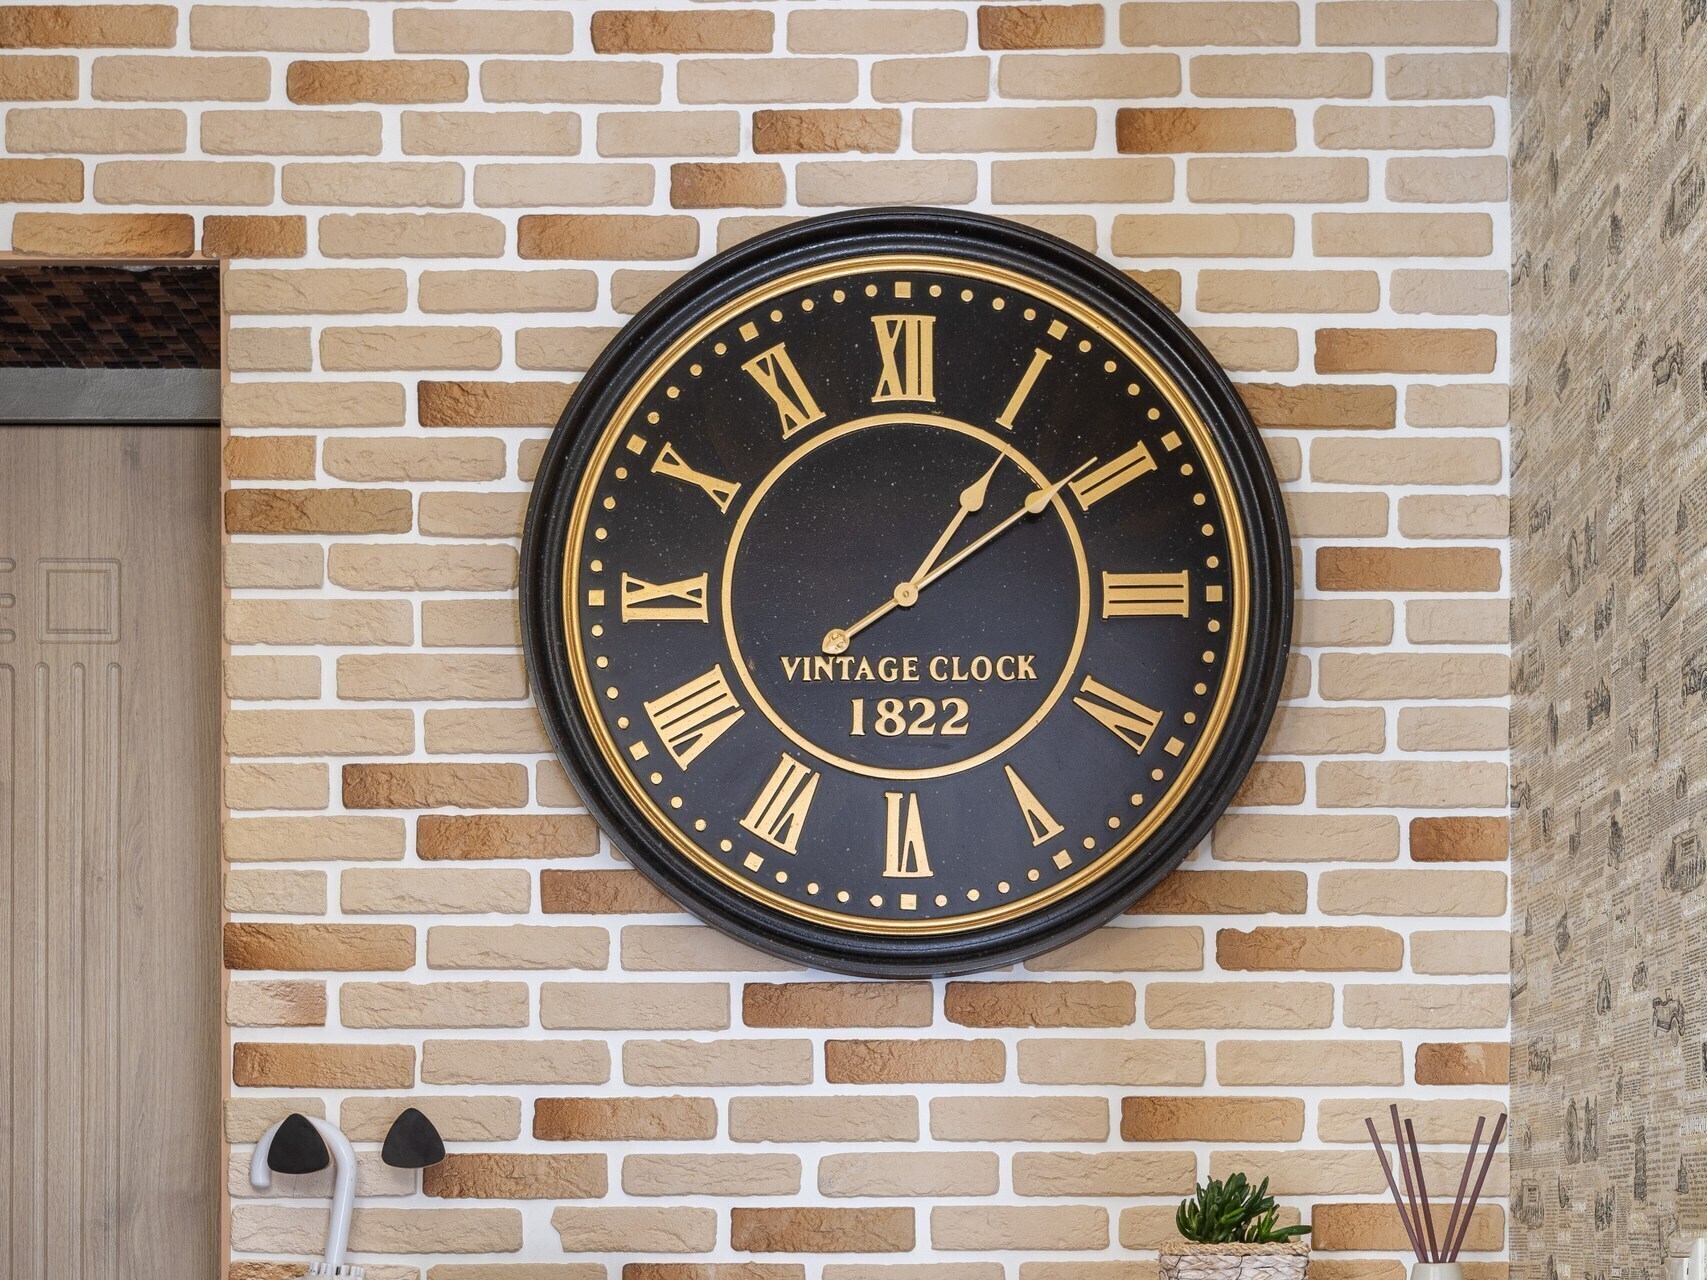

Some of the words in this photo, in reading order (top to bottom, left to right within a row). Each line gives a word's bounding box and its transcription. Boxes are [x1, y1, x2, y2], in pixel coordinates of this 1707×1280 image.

[741, 342, 827, 440] XI
[871, 314, 937, 403] XII
[995, 348, 1052, 430] I
[651, 442, 742, 514] X
[1069, 440, 1158, 511] II
[621, 572, 710, 624] IX
[1102, 569, 1190, 619] III
[780, 655, 921, 683] VINTAGE
[928, 655, 1038, 682] CLOCK
[643, 664, 746, 772] VIII
[850, 697, 969, 737] 1822
[1073, 674, 1163, 755] IV
[739, 751, 821, 855] VII
[882, 792, 934, 878] VI
[1005, 764, 1064, 846] V
